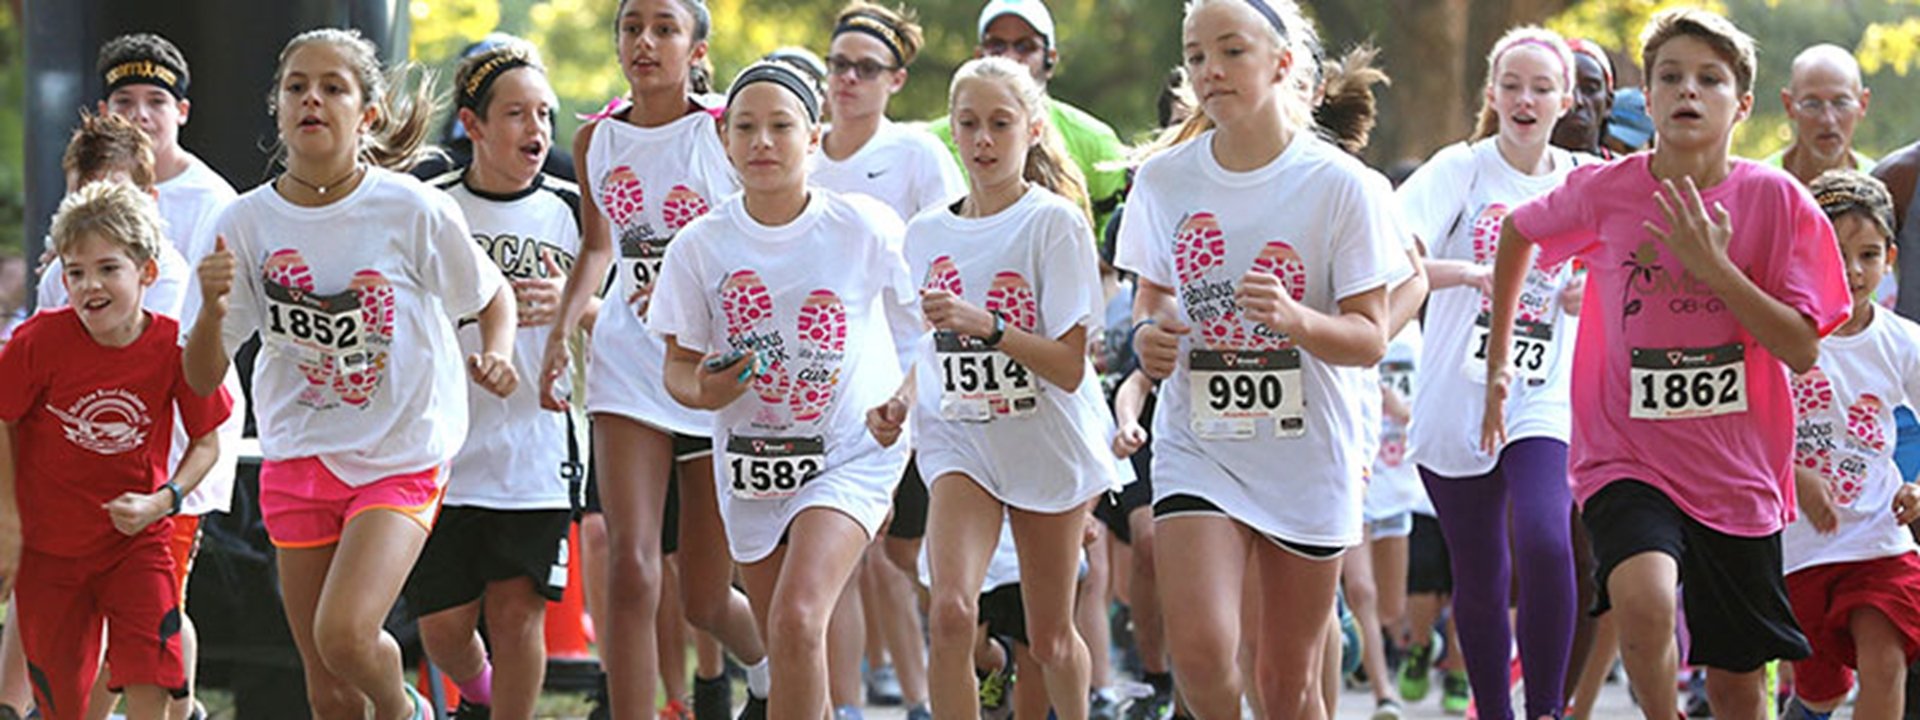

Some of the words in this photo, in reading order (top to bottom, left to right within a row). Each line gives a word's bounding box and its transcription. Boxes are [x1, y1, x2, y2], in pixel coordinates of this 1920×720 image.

[633, 261, 663, 285] 9
[268, 304, 358, 349] 1852
[1474, 333, 1546, 371] 173
[943, 355, 1029, 392] 1514
[1208, 373, 1283, 409] 990
[1641, 367, 1739, 410] 1862
[731, 457, 818, 491] 1582
